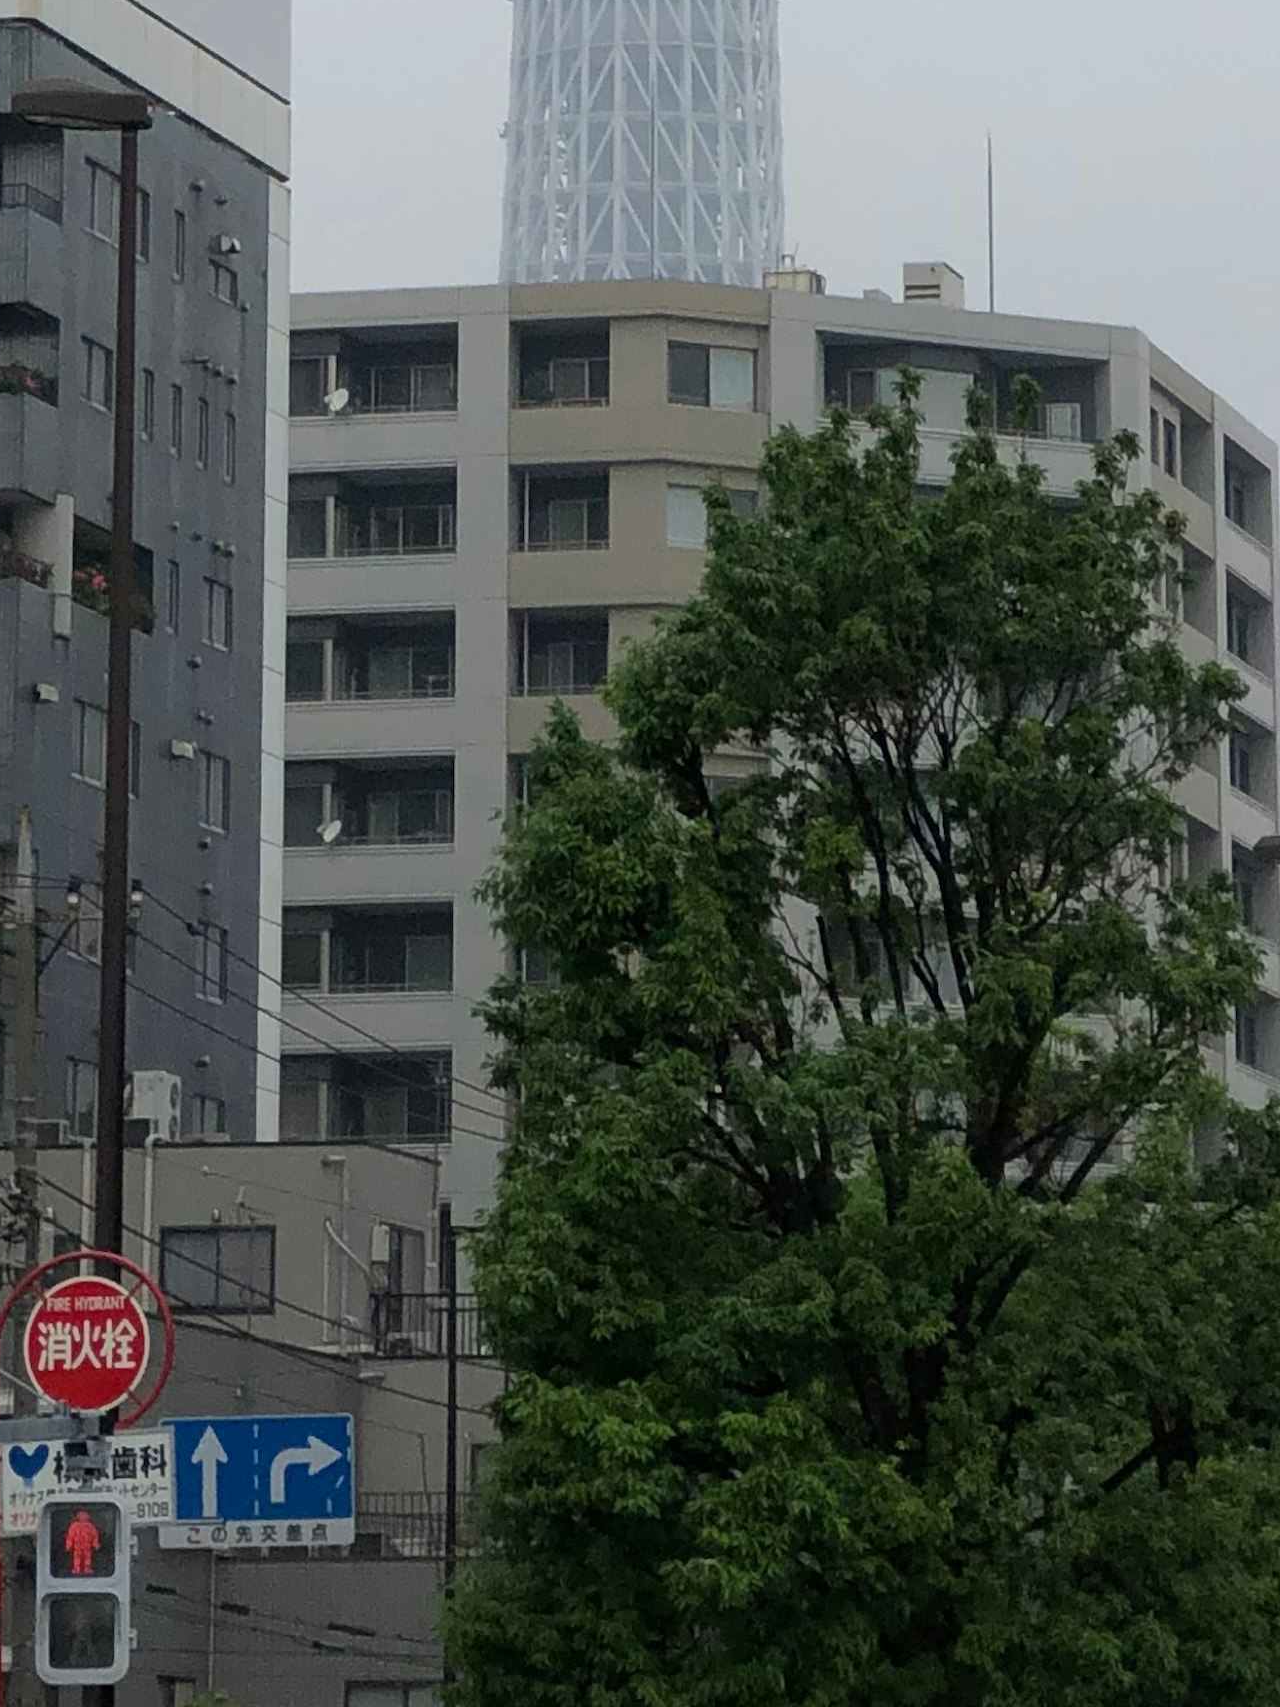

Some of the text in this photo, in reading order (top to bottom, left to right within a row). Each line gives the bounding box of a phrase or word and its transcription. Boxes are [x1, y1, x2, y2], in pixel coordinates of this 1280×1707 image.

[46, 1296, 126, 1312] FIRE HYDRANT
[37, 1318, 137, 1371] 消火栓
[186, 1523, 329, 1544] この先交差点
